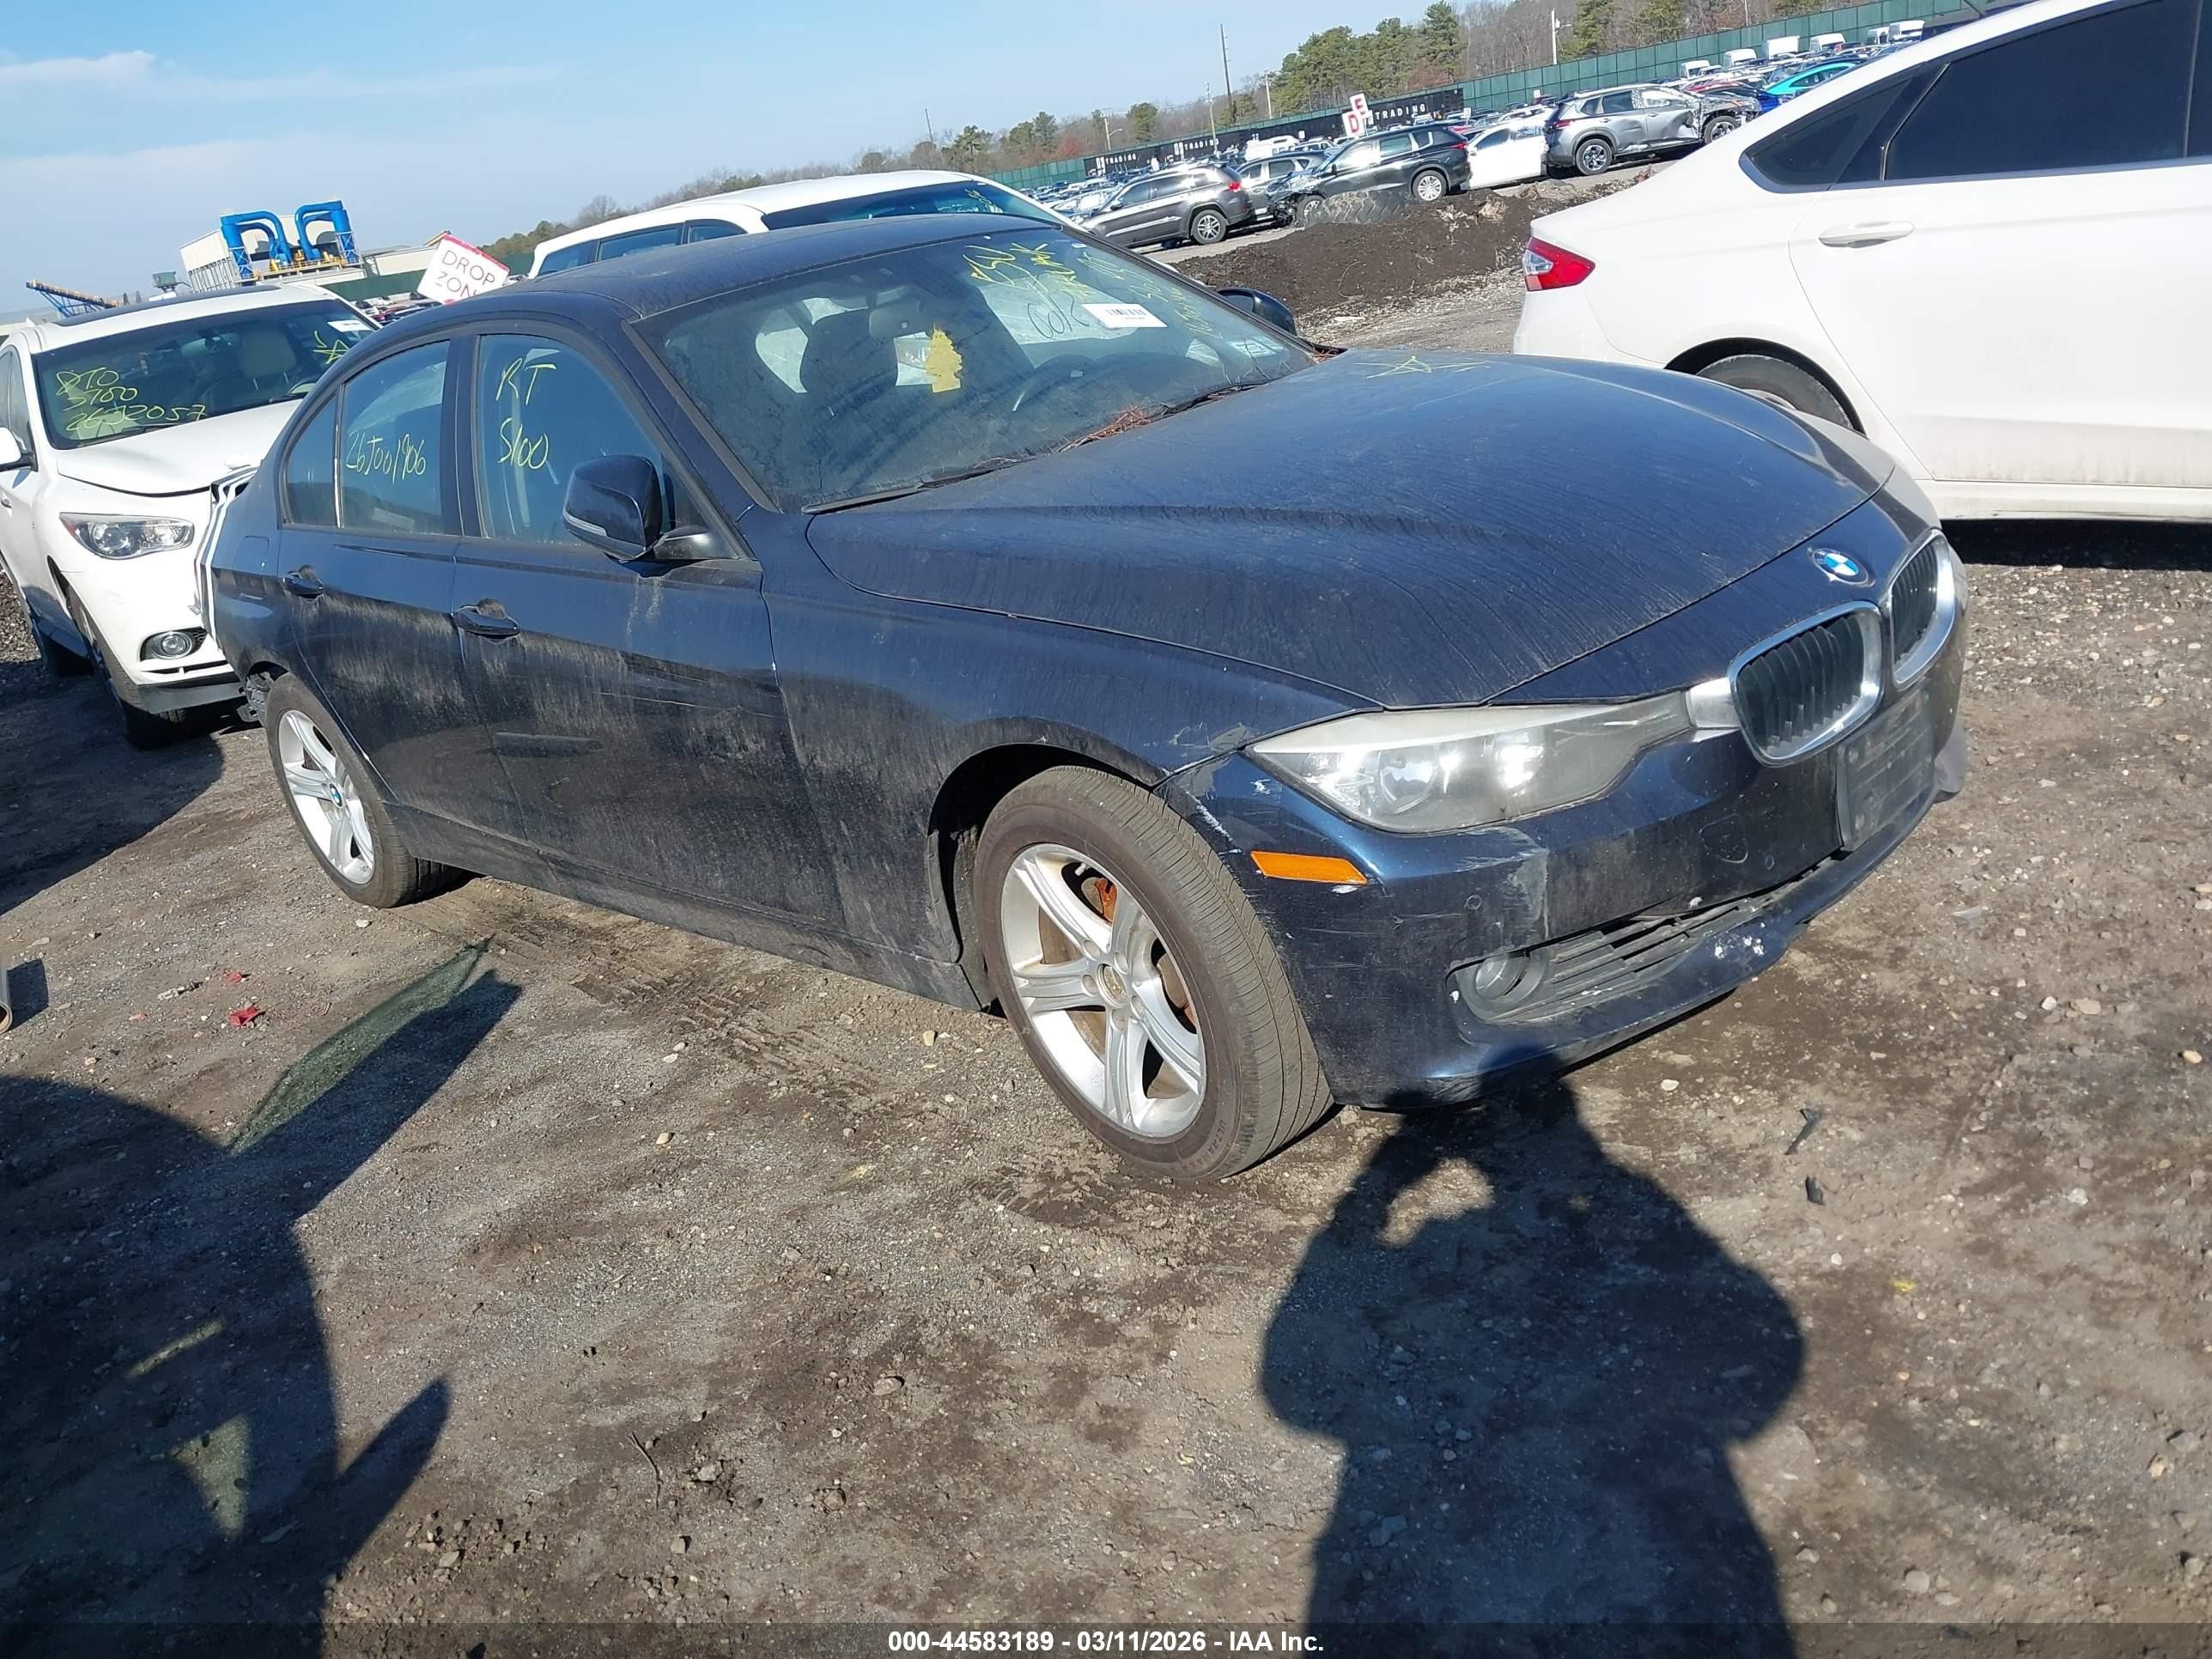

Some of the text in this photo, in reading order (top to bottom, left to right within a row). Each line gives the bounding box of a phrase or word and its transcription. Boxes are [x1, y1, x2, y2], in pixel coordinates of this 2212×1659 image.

[1375, 103, 1426, 120] TRADING
[1105, 152, 1137, 165] TRADING
[441, 249, 495, 287] DROP
[434, 270, 480, 298] ZON
[495, 357, 557, 406] RT
